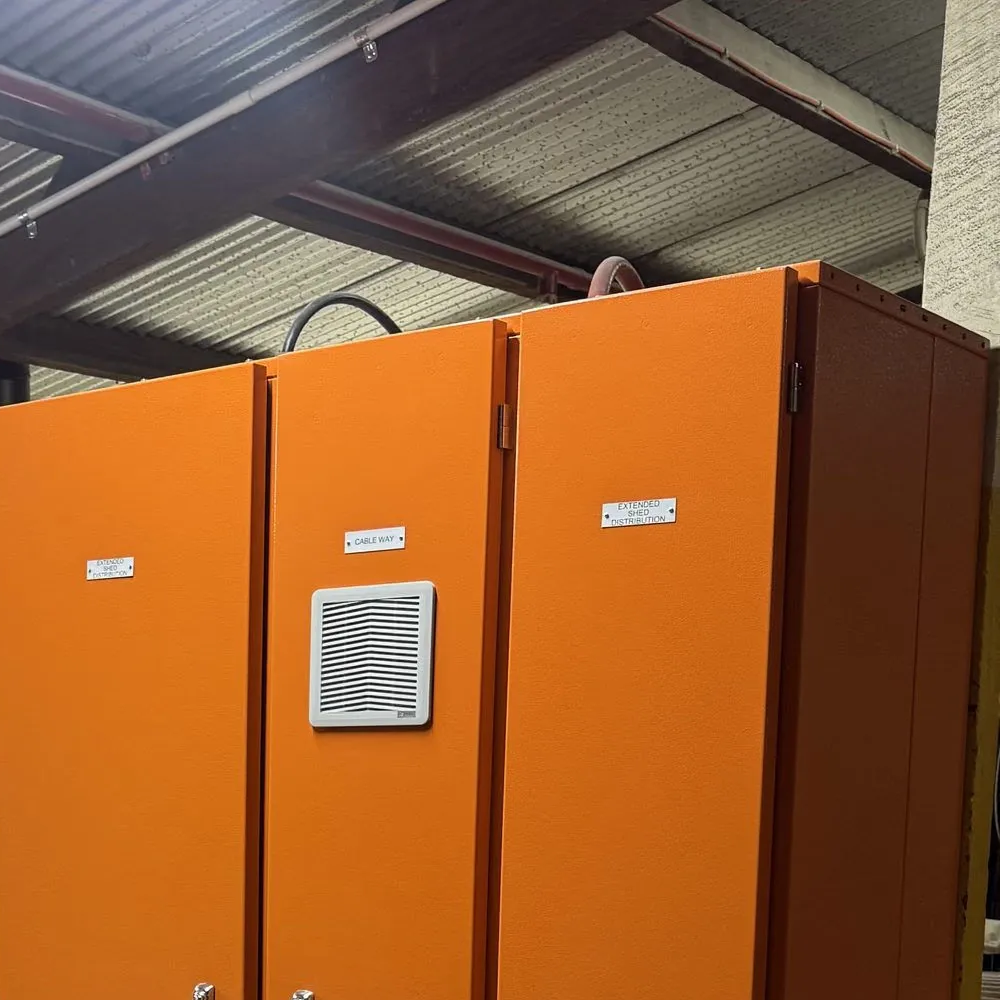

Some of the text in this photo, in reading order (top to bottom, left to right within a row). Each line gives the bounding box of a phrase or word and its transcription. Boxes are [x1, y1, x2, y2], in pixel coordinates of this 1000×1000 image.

[618, 500, 660, 510] EXTENDED
[628, 509, 649, 517] SHED
[611, 516, 666, 526] DISTRIBUTION
[354, 535, 394, 546] CABLE WAY
